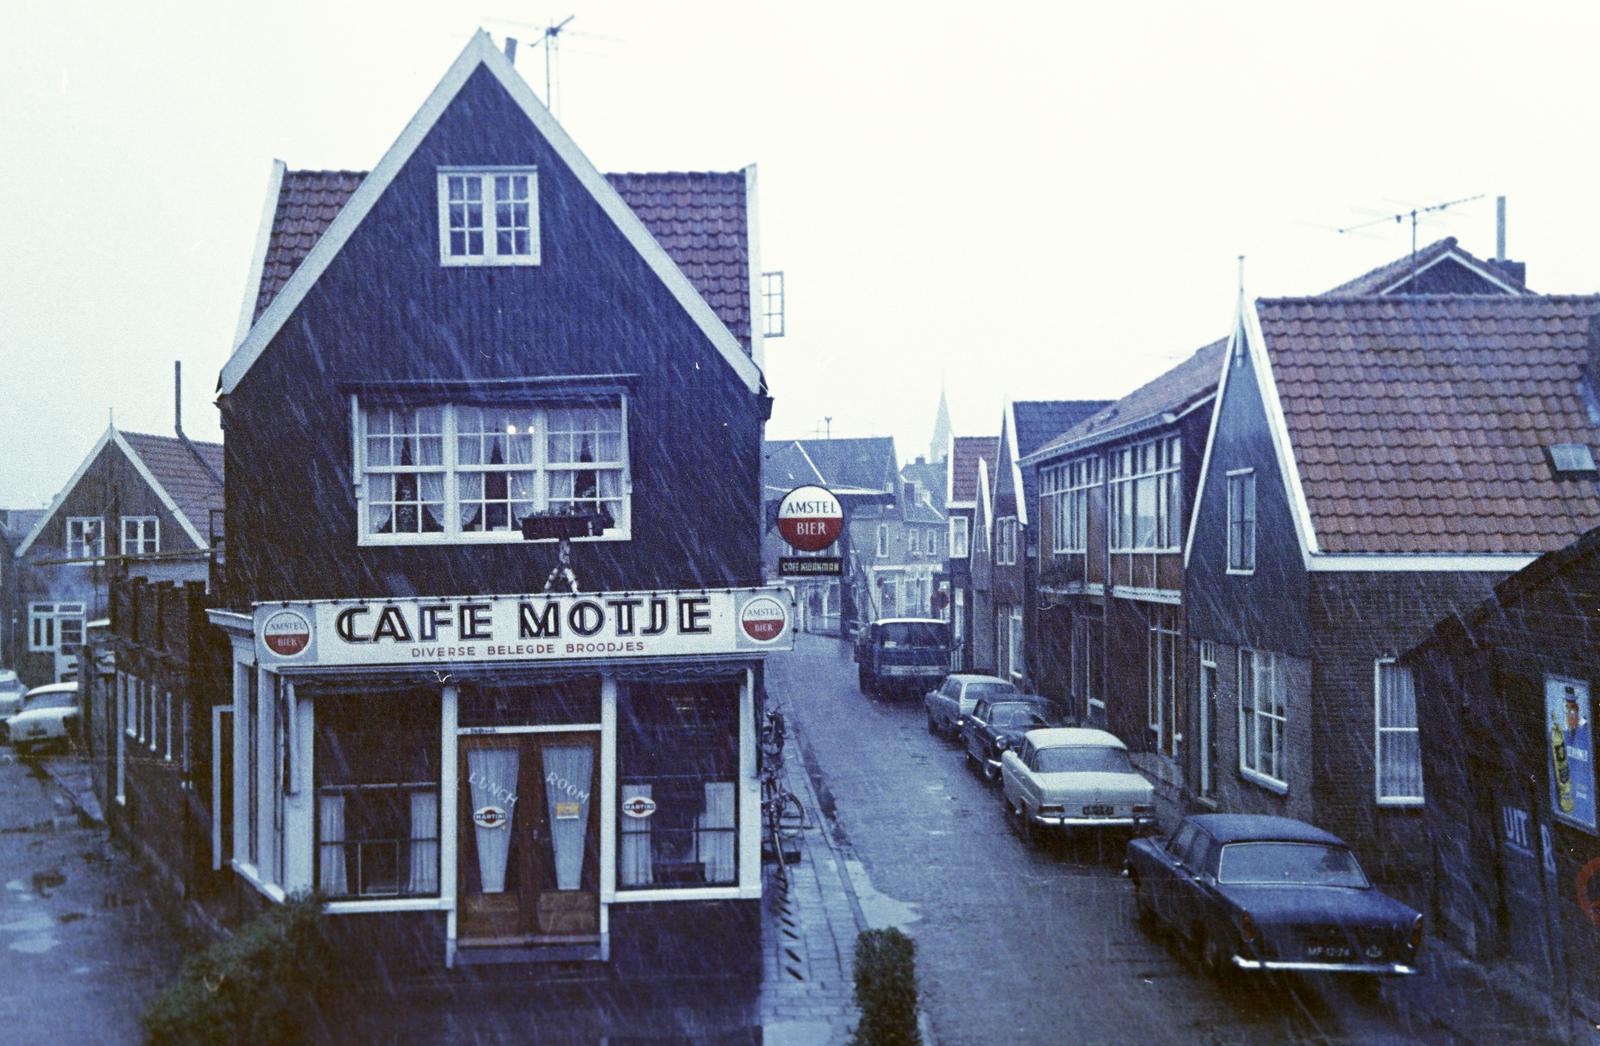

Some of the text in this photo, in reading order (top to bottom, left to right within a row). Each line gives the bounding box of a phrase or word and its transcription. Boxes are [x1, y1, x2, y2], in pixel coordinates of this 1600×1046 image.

[786, 501, 837, 514] AMSTEL
[797, 522, 827, 535] BIER
[748, 606, 781, 617] AMSTEL
[270, 621, 304, 631] AMSTEL
[335, 597, 711, 644] CAFE MOTJE
[754, 623, 774, 632] BIER
[277, 637, 298, 647] BIER
[411, 641, 645, 658] DIVERSE BELEGDE BROODJES
[468, 772, 518, 808] LUNCH
[547, 770, 590, 805] ROOM
[624, 803, 655, 811] MARTINI
[475, 813, 506, 821] MARTINI
[1503, 805, 1528, 847] UIT
